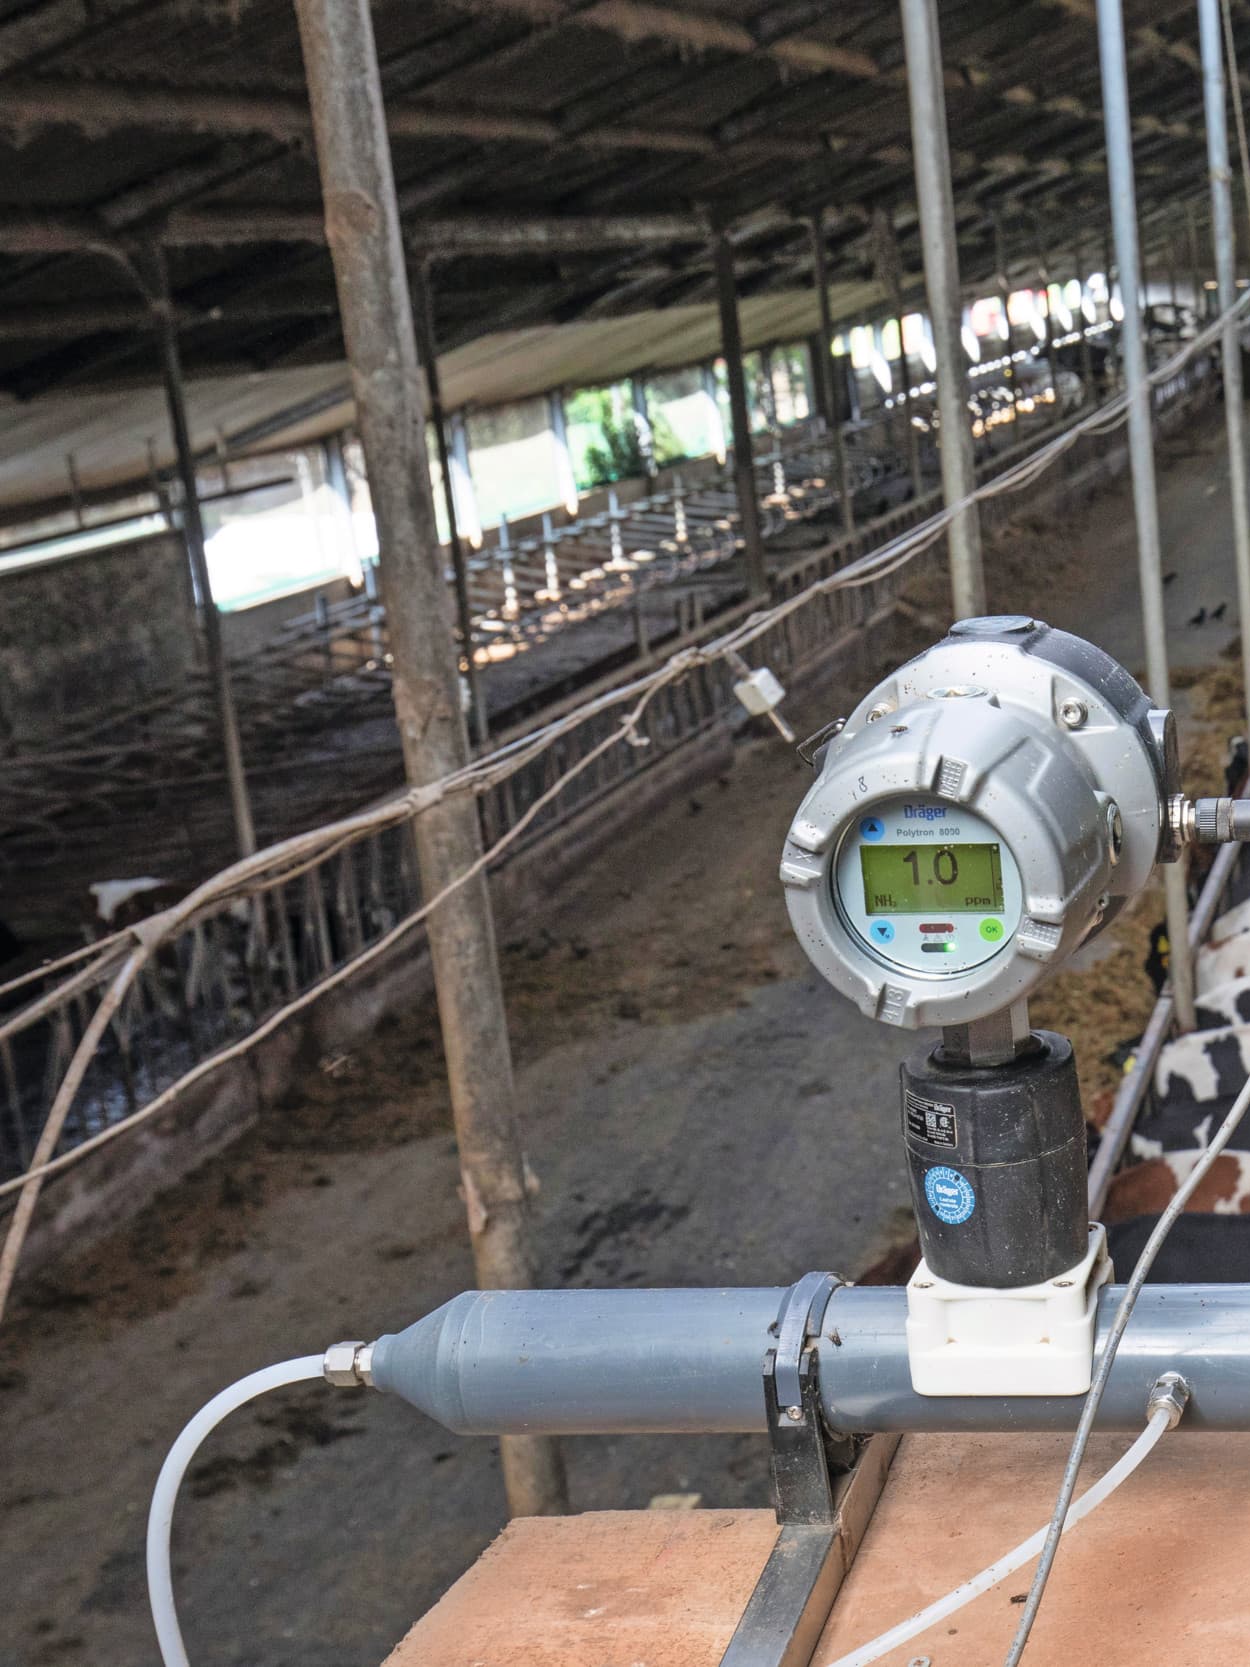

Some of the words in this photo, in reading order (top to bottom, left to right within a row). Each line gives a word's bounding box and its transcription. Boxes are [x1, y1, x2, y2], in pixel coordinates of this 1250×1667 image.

[903, 804, 948, 821] Dräger
[896, 828, 934, 838] Polytron
[902, 849, 959, 886] 1.0
[965, 896, 991, 906] ppm
[985, 926, 998, 934] OK
